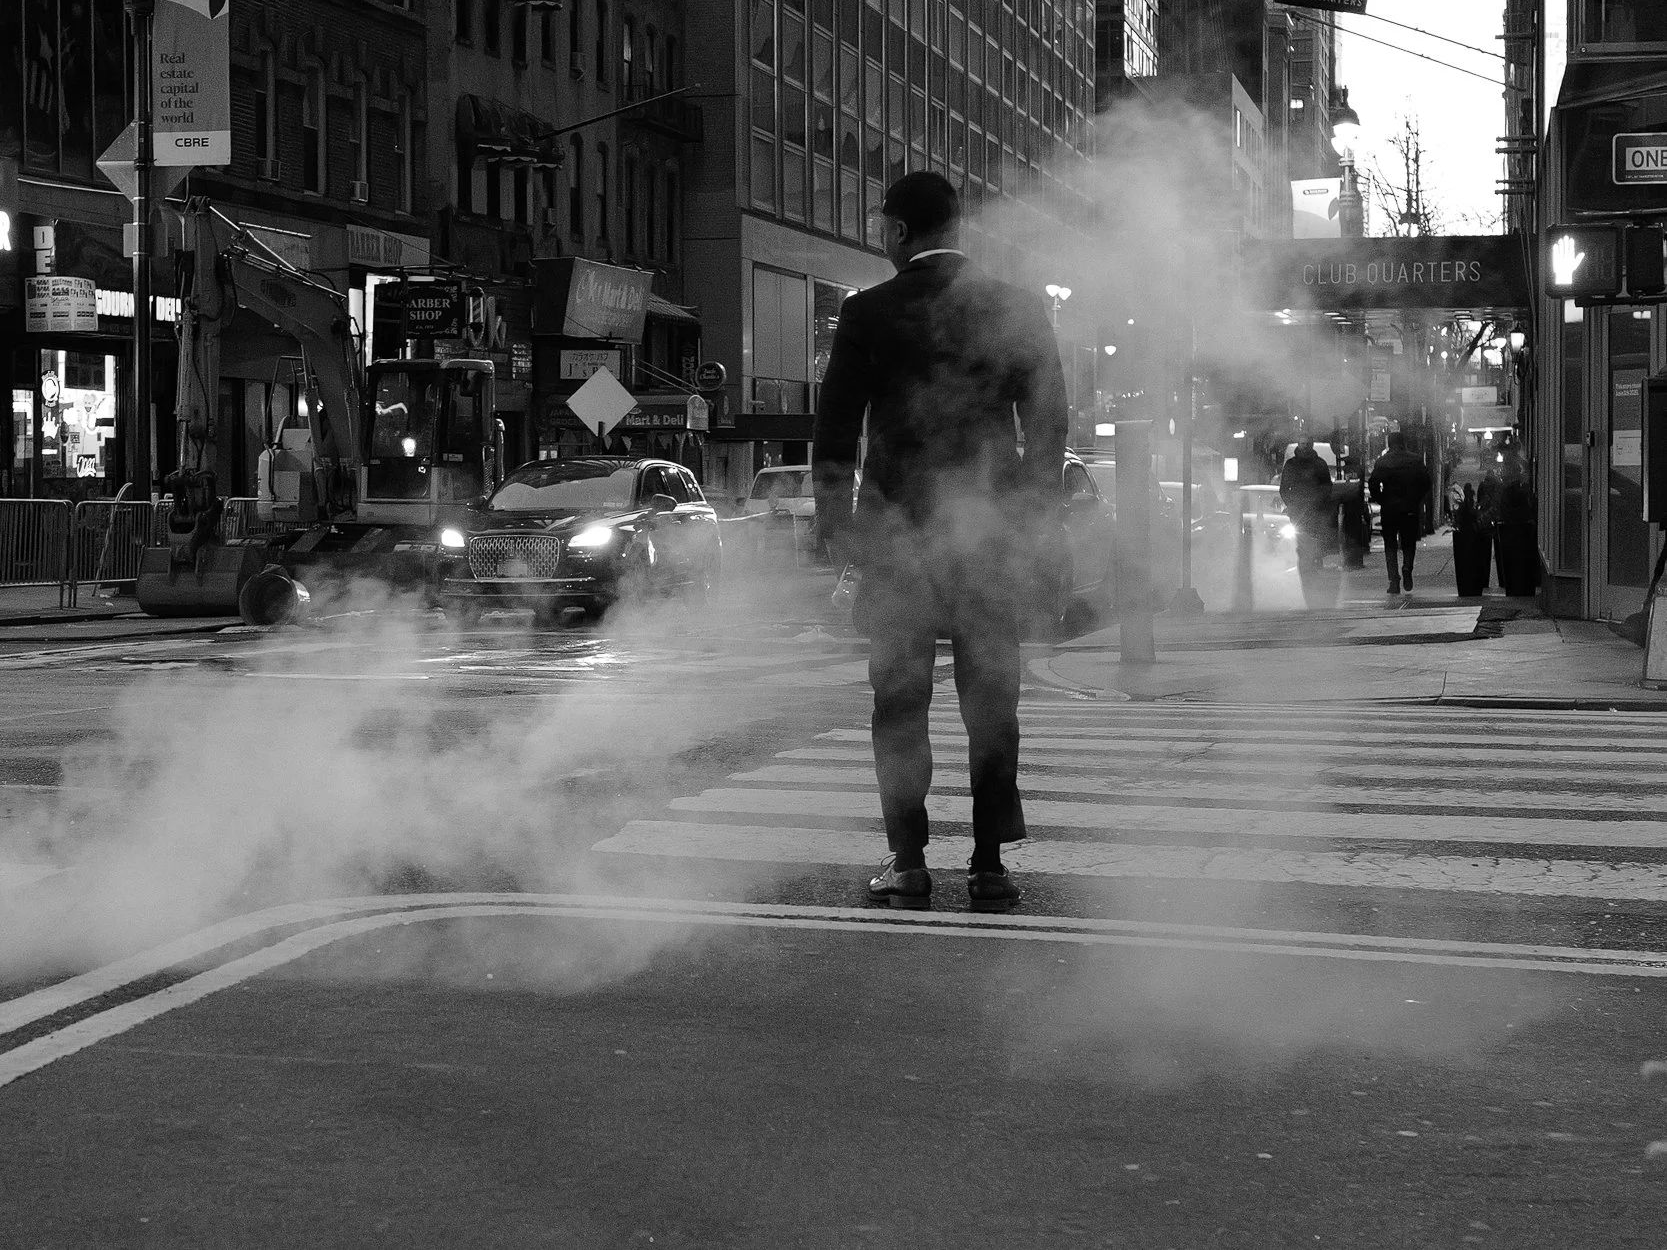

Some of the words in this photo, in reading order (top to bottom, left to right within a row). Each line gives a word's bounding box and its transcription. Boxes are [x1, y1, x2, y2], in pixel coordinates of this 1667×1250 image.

[160, 52, 186, 64] Real
[160, 69, 194, 79] estate
[160, 82, 199, 97] capital
[160, 97, 172, 109] of
[174, 97, 193, 109] the
[161, 112, 194, 124] world
[174, 137, 210, 147] CBRE
[1631, 149, 1667, 168] ONE
[1302, 263, 1357, 285] CLUB
[1366, 260, 1482, 285] QUARTERS
[407, 298, 451, 309] ARBER
[409, 310, 443, 321] SHOP
[625, 414, 650, 426] Mart
[652, 414, 661, 426] &
[662, 413, 685, 426] Deli
